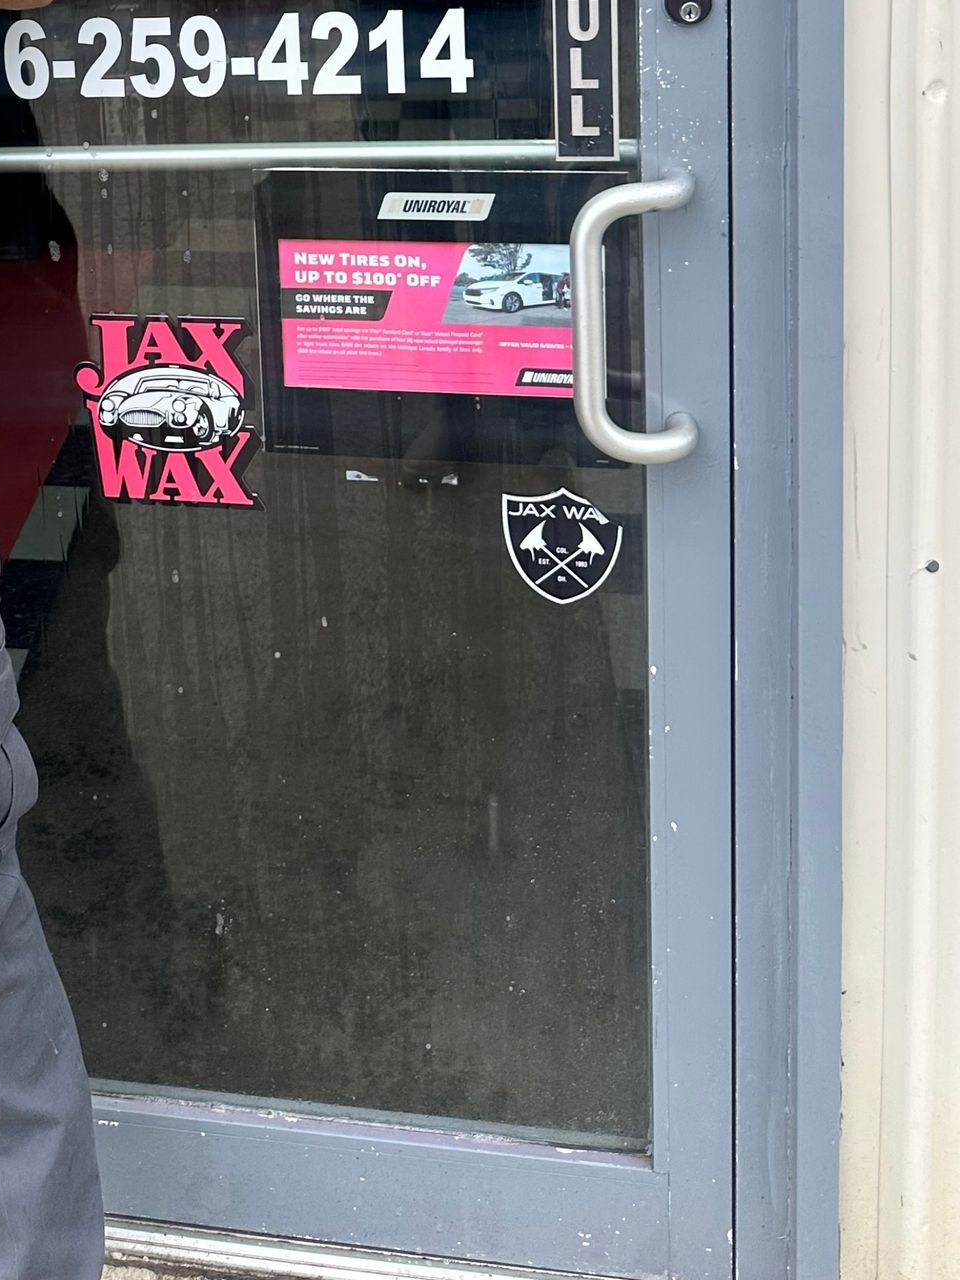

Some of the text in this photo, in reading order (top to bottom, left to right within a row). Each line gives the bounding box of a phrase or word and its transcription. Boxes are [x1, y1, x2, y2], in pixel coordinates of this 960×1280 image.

[402, 199, 469, 214] UNIROYAL
[293, 251, 427, 271] NEW TIRES ON,
[294, 270, 321, 284] UP
[323, 270, 348, 285] TO
[405, 272, 441, 287] OFF
[295, 293, 375, 304] GO WHERE THE
[295, 304, 367, 315] SAVINGS ARE
[76, 319, 245, 399] JAX
[532, 371, 574, 385] UNIROYA
[86, 399, 254, 505] WAX
[508, 502, 601, 521] JAX WA
